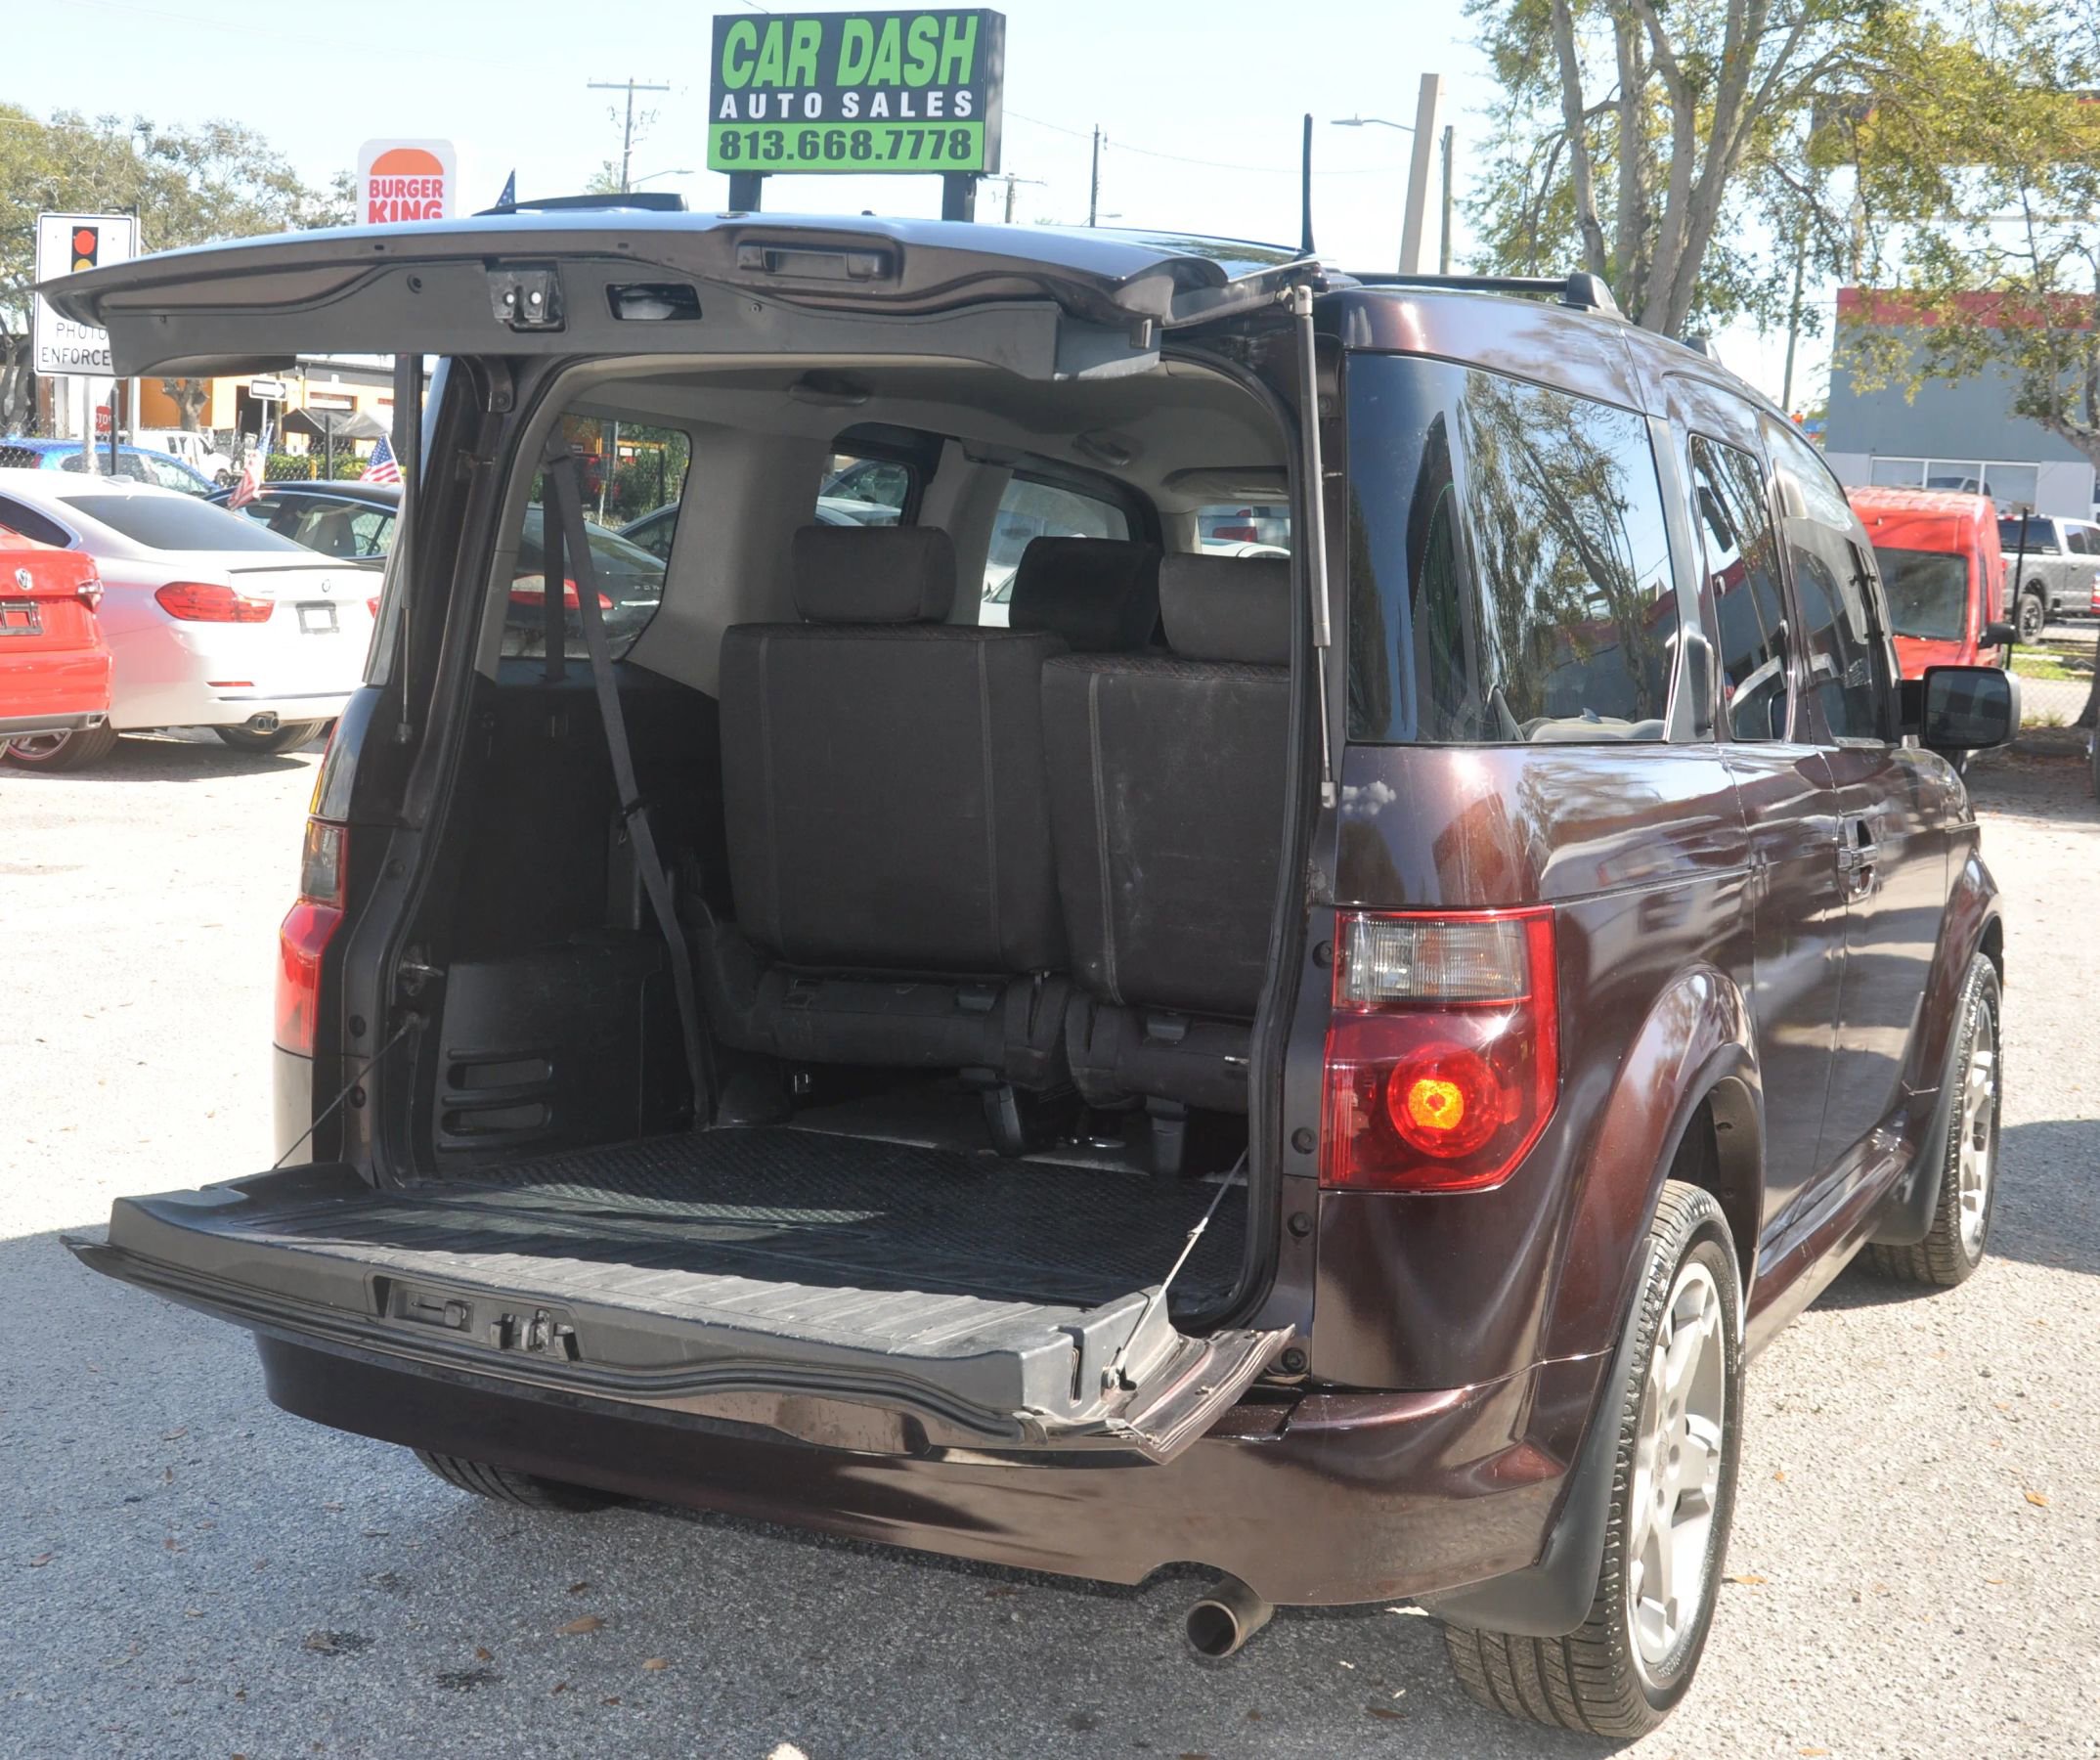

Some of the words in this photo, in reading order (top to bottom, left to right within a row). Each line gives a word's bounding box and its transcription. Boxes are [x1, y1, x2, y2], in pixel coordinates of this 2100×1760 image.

[722, 20, 822, 89] CAR
[836, 16, 978, 87] DASH
[719, 93, 822, 118] AUTO
[841, 91, 973, 117] SALES
[719, 128, 972, 160] 813.668.7778
[369, 179, 444, 198] BURGER
[369, 199, 443, 224] KING
[56, 322, 108, 340] PHOTO
[42, 346, 110, 367] ENFORCE
